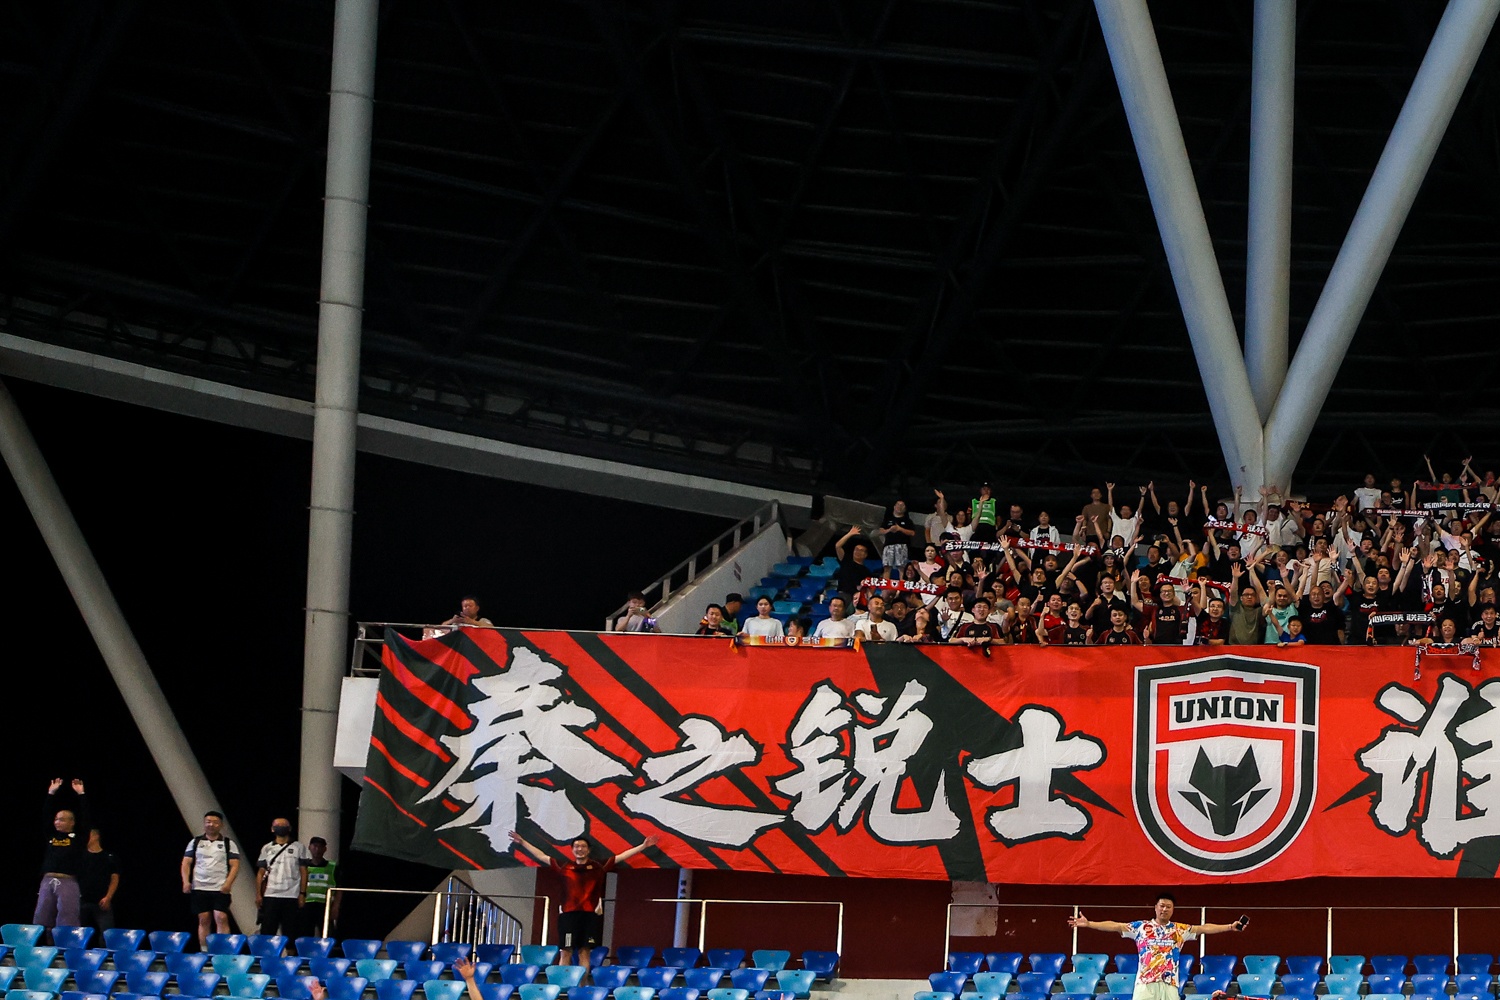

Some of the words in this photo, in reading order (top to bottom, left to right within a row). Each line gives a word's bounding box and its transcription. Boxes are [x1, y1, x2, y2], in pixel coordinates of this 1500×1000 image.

[416, 646, 1103, 854] 秦之锐士
[1173, 695, 1280, 724] UNION
